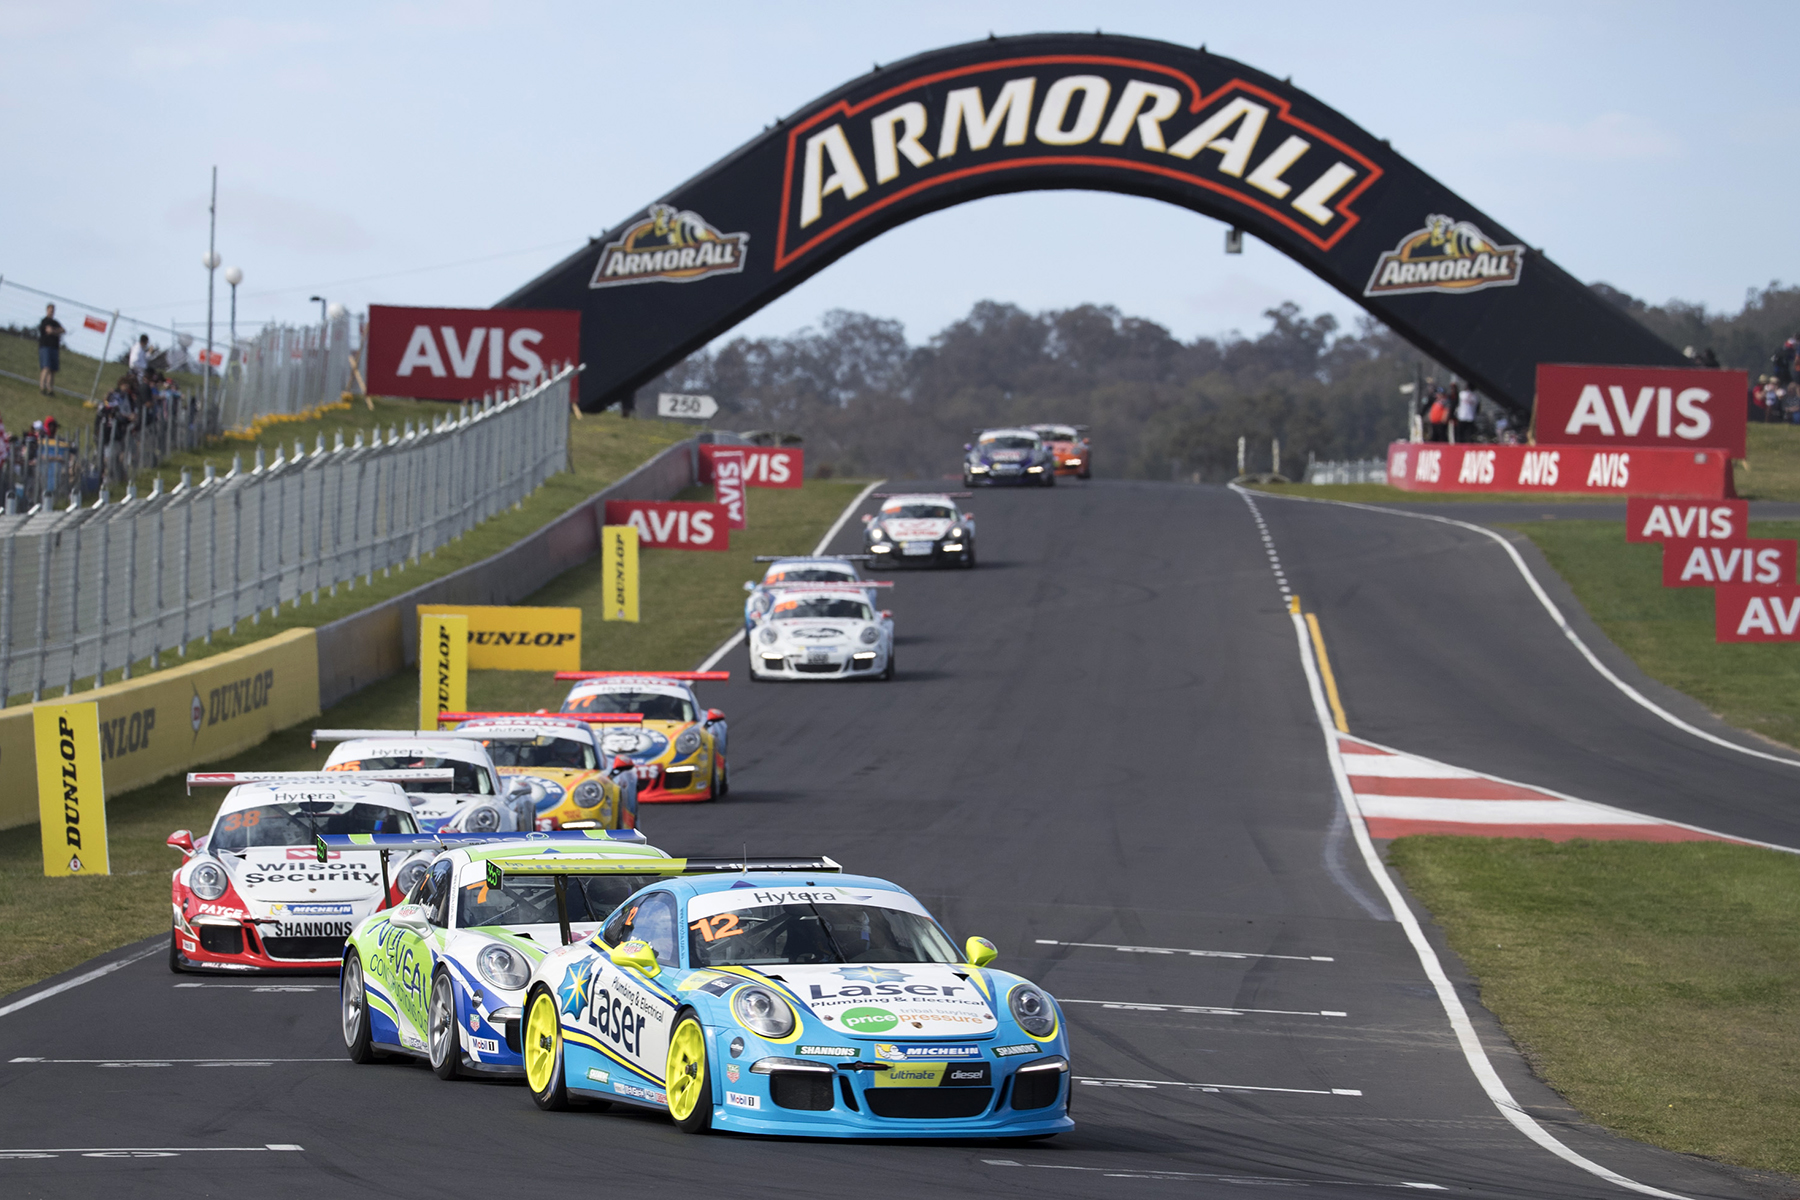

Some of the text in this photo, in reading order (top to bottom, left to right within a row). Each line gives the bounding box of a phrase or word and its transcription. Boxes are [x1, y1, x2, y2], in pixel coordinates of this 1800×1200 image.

[800, 75, 1356, 228] ARMORALL
[604, 242, 735, 277] ARMORALL
[1379, 252, 1510, 286] ARMORALL
[396, 324, 545, 382] AVIS
[668, 398, 701, 414] 250
[1564, 384, 1712, 440] AVIS
[743, 452, 792, 484] VIS
[1415, 449, 1441, 483] AVIS
[1458, 449, 1496, 484] AVIS
[1518, 450, 1560, 486] AVIS
[1586, 452, 1630, 487] AVIS
[717, 461, 743, 522] AVIS
[626, 508, 714, 545] AVIS
[1641, 504, 1735, 539] AVIS
[1679, 546, 1783, 584] AVIS
[1736, 596, 1800, 635] AV
[207, 669, 274, 727] DUNLOP
[99, 707, 156, 762] NLOP
[371, 748, 424, 759] Hytera
[58, 715, 82, 851] DUNLOP
[275, 792, 336, 803] Hytera
[224, 810, 261, 831] 38
[245, 871, 380, 884] Security
[256, 862, 367, 872] Wilson
[466, 880, 489, 904] 7
[753, 890, 837, 905] Hytera
[291, 905, 352, 914] MICHELIN
[275, 922, 353, 937] SHANNONS
[689, 913, 744, 942] 12
[611, 975, 665, 1023] Plumbing & Electrical
[809, 983, 966, 1000] Laser
[811, 997, 891, 1008] Plumbing
[912, 996, 985, 1006] Electrical
[588, 966, 646, 1058] Laser
[845, 1013, 898, 1028] price
[898, 1013, 984, 1025] pressure
[472, 1037, 488, 1050] Mobil
[799, 1046, 856, 1057] SHANNONS
[905, 1046, 980, 1056] MICHELIN
[995, 1043, 1040, 1057] SHANNONS
[889, 1069, 936, 1081] ultimate
[950, 1068, 983, 1080] diesel
[730, 1093, 747, 1106] Mobil
